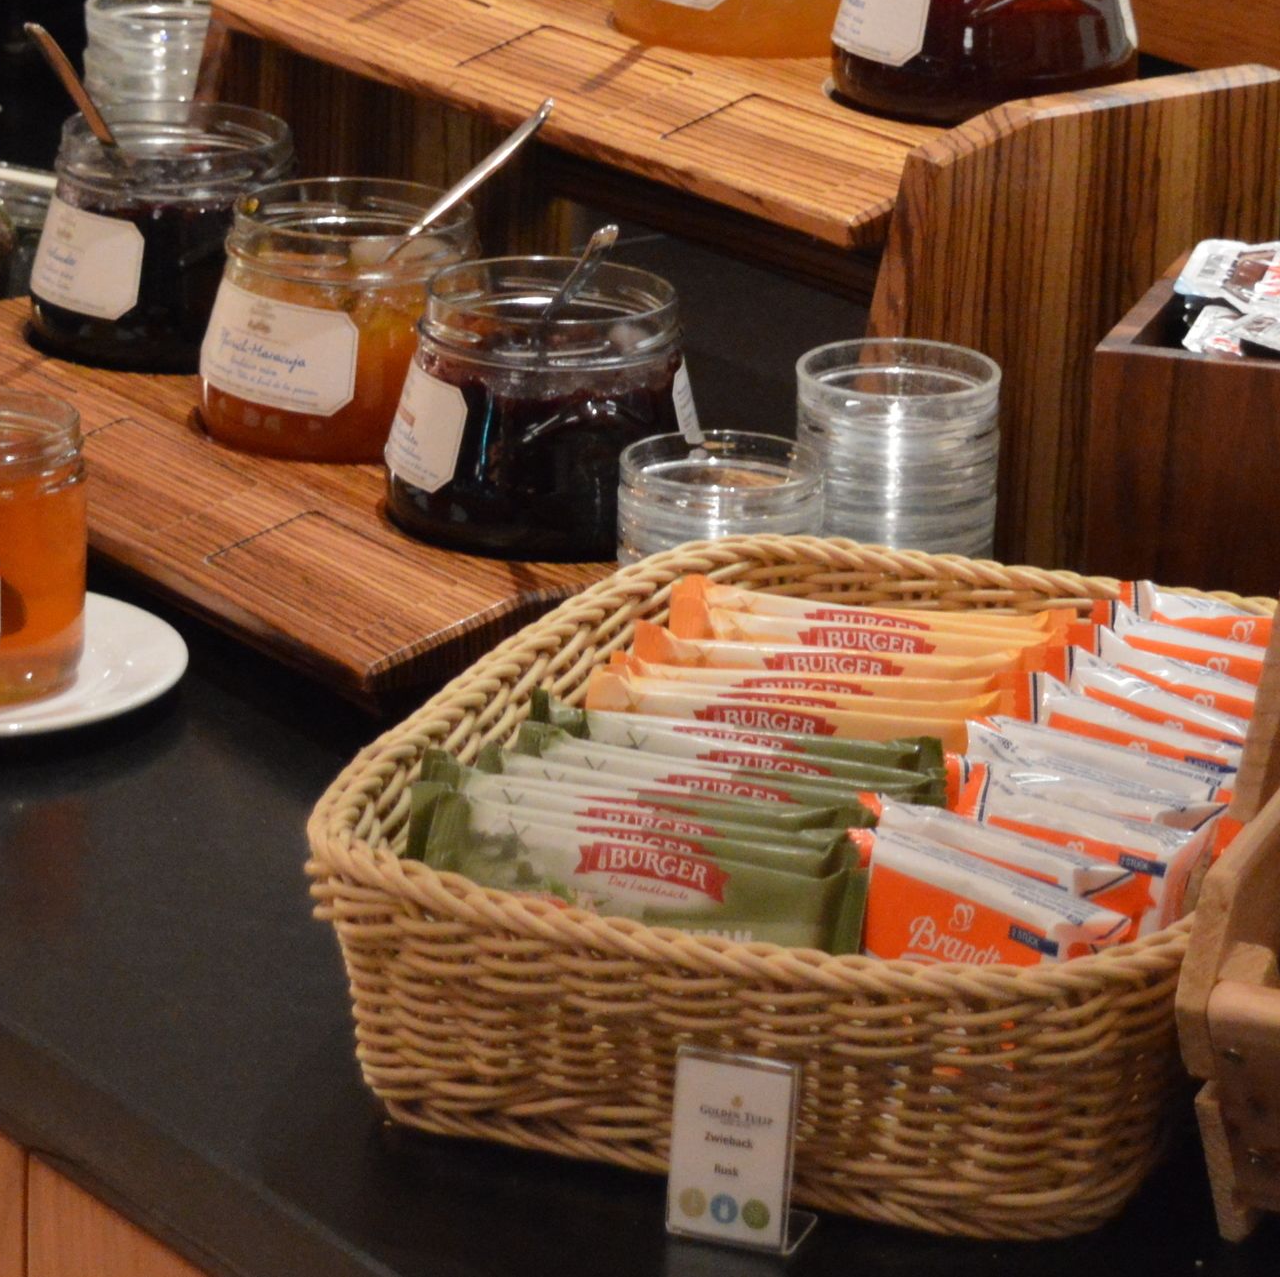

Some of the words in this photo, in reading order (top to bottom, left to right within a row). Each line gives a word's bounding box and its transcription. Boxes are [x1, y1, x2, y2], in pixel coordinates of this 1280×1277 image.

[825, 629, 917, 654] BURGER
[792, 655, 885, 676] BURGER
[723, 709, 816, 735] BURGER
[608, 846, 708, 890] BURGER
[907, 915, 1002, 965] Brandt
[704, 1130, 754, 1150] Zwieback
